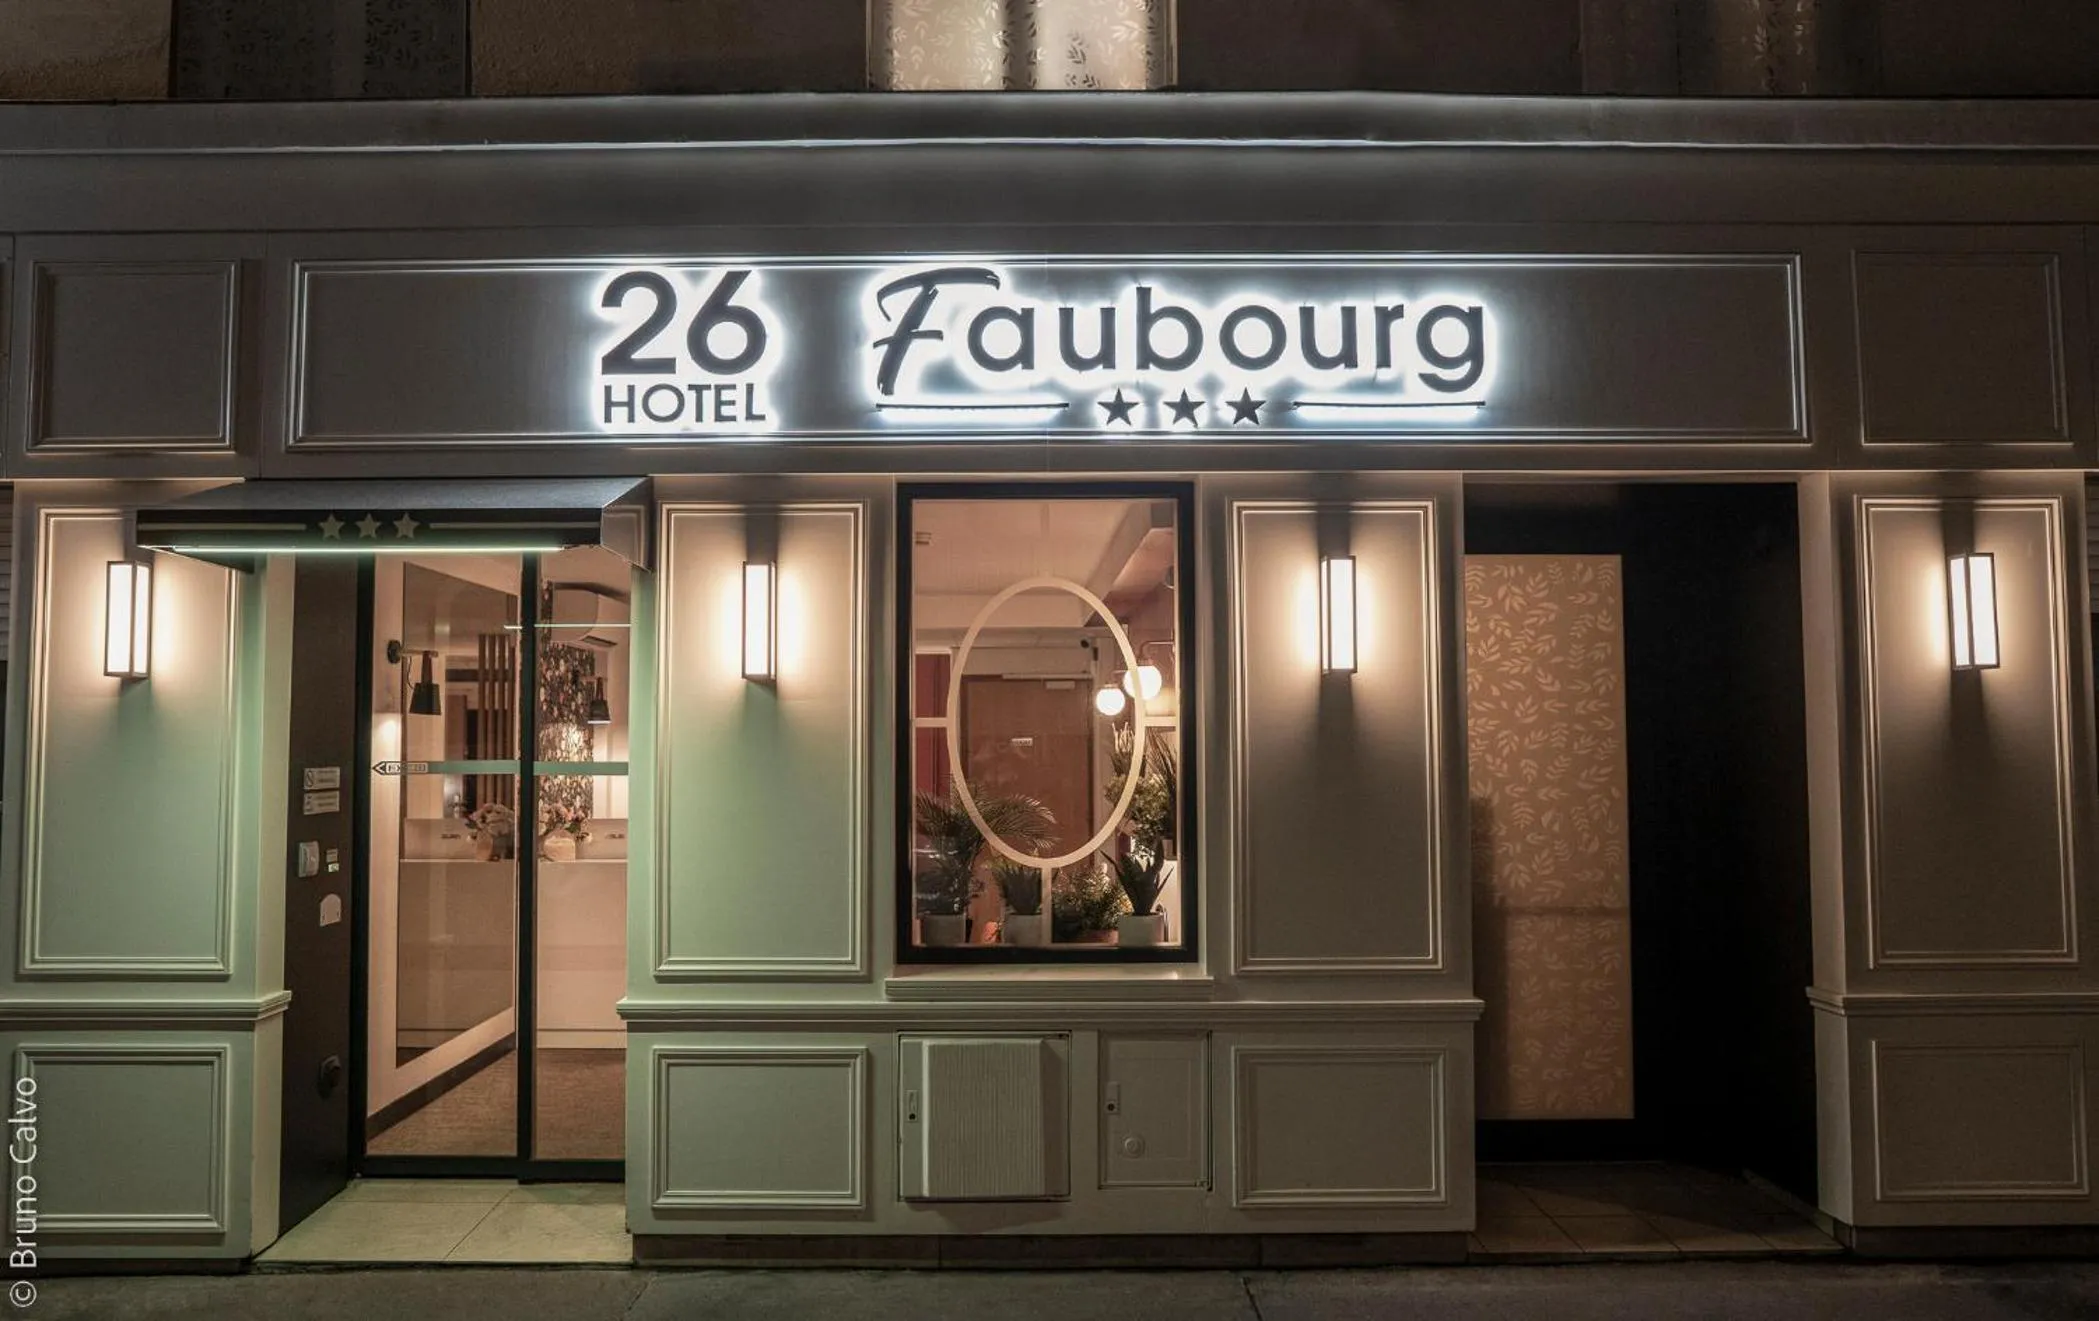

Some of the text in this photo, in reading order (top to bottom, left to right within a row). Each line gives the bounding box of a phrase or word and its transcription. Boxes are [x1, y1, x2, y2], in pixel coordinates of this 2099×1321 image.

[601, 269, 767, 376] 26
[873, 267, 1485, 393] Faubourg
[603, 382, 766, 424] HOTEL
